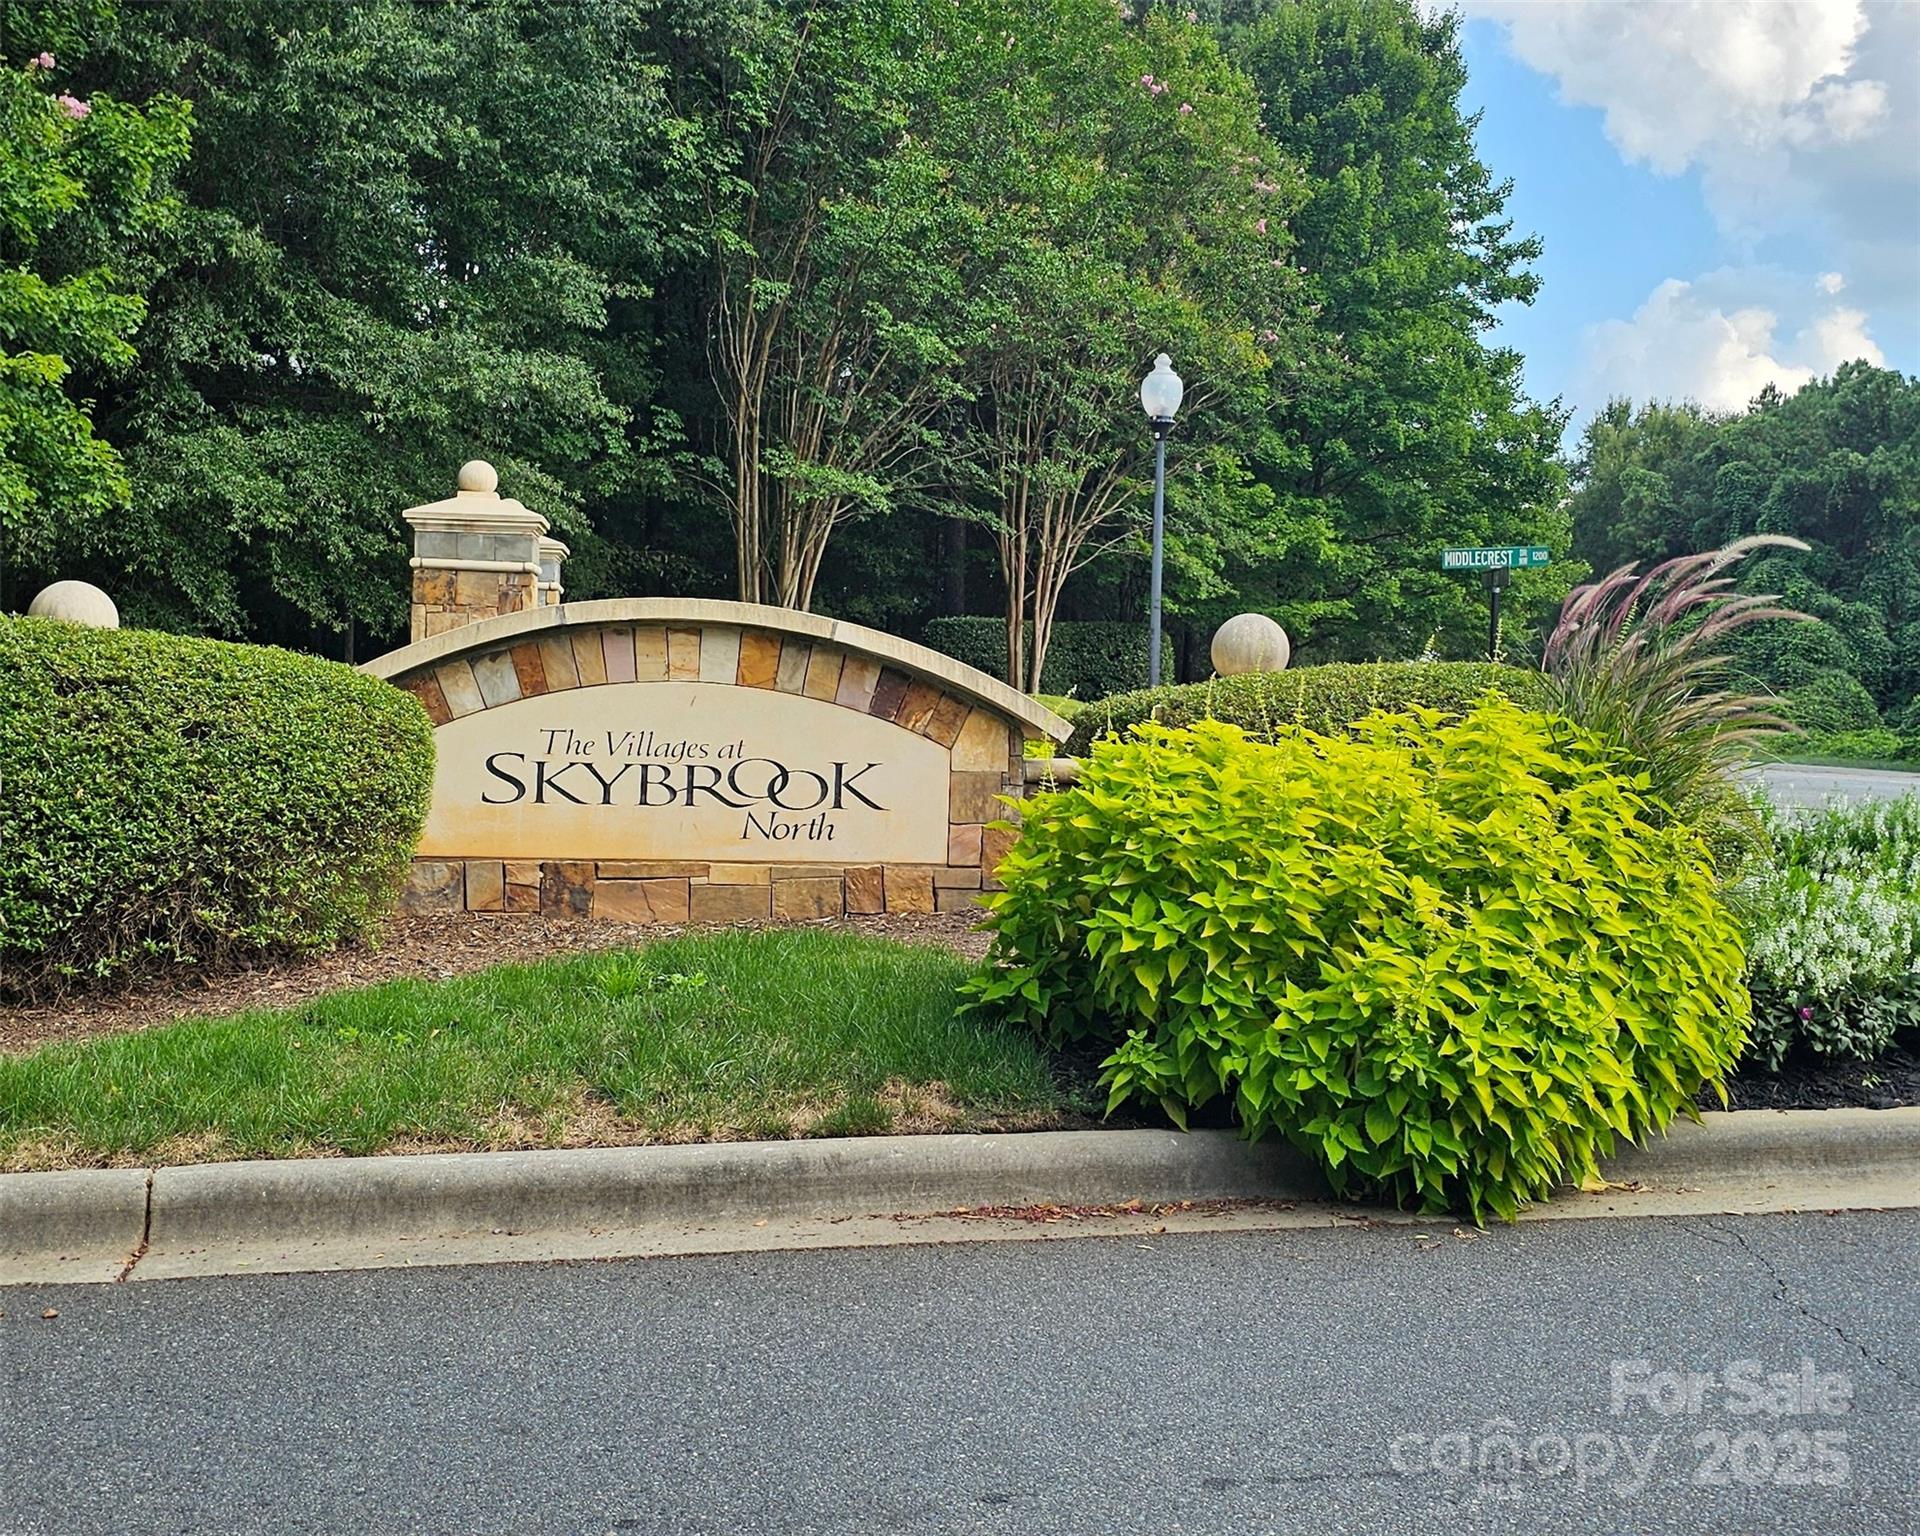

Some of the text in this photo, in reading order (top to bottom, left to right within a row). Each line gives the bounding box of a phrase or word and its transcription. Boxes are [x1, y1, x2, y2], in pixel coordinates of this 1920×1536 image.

[1444, 551, 1513, 566] MIDDLECREST
[1532, 551, 1548, 561] 1200
[538, 729, 746, 764] The Villages at
[482, 752, 891, 811] SKYBROOK
[741, 811, 836, 841] North
